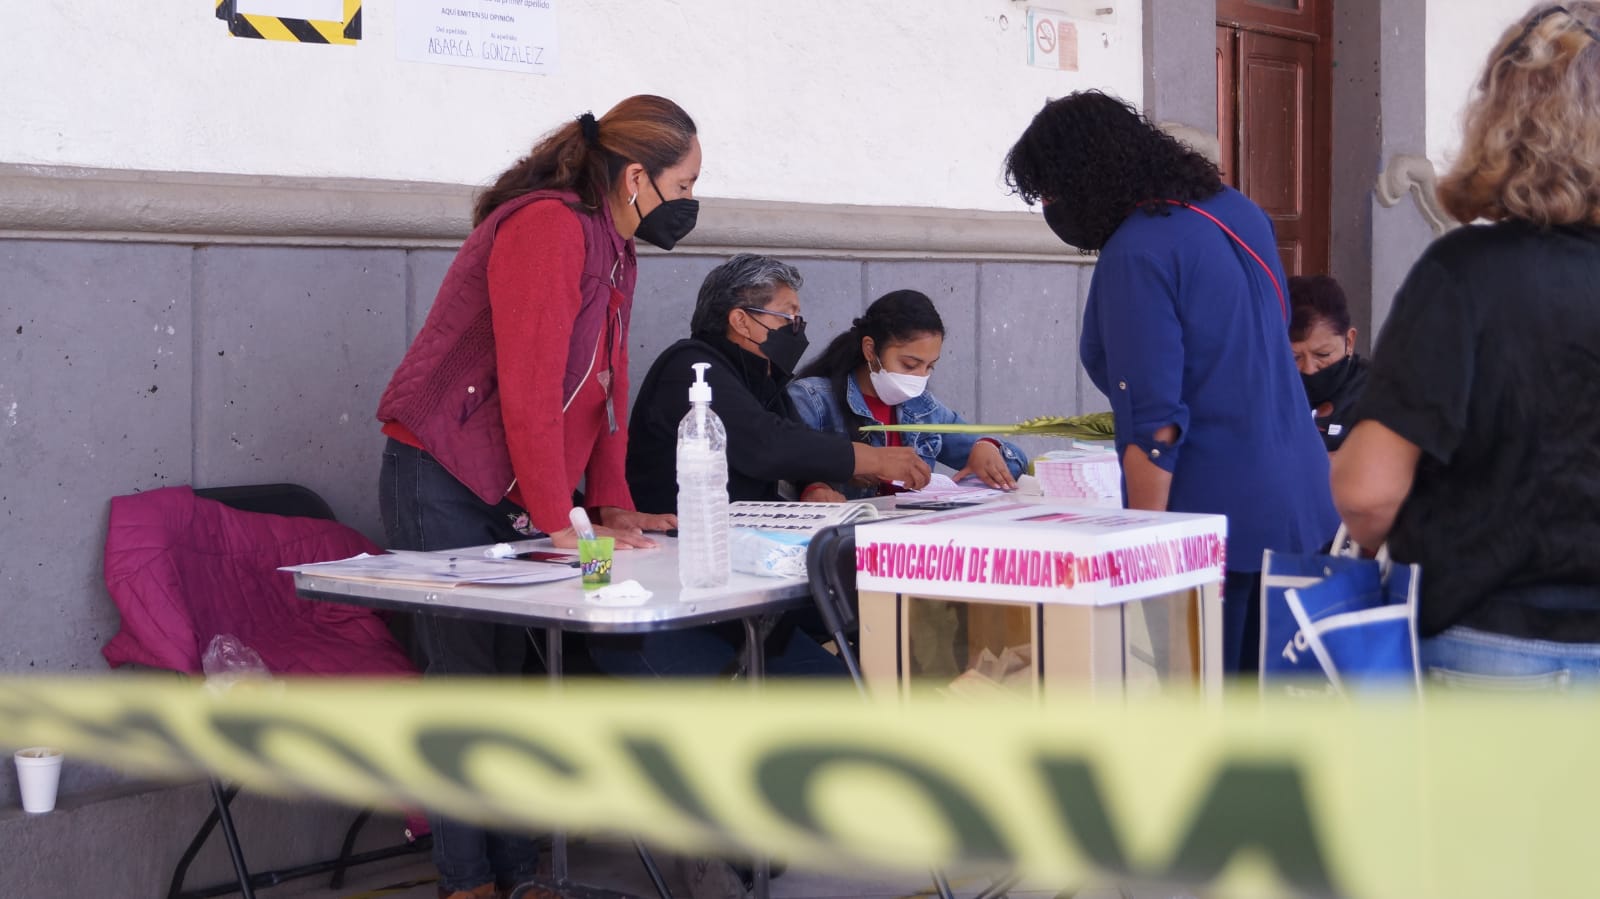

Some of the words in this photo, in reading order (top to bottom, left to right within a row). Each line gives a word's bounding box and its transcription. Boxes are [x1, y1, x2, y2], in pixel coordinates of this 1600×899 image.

[428, 37, 474, 57] ABARCA
[870, 538, 965, 582] REVOCACIÓN
[967, 547, 989, 583] DE
